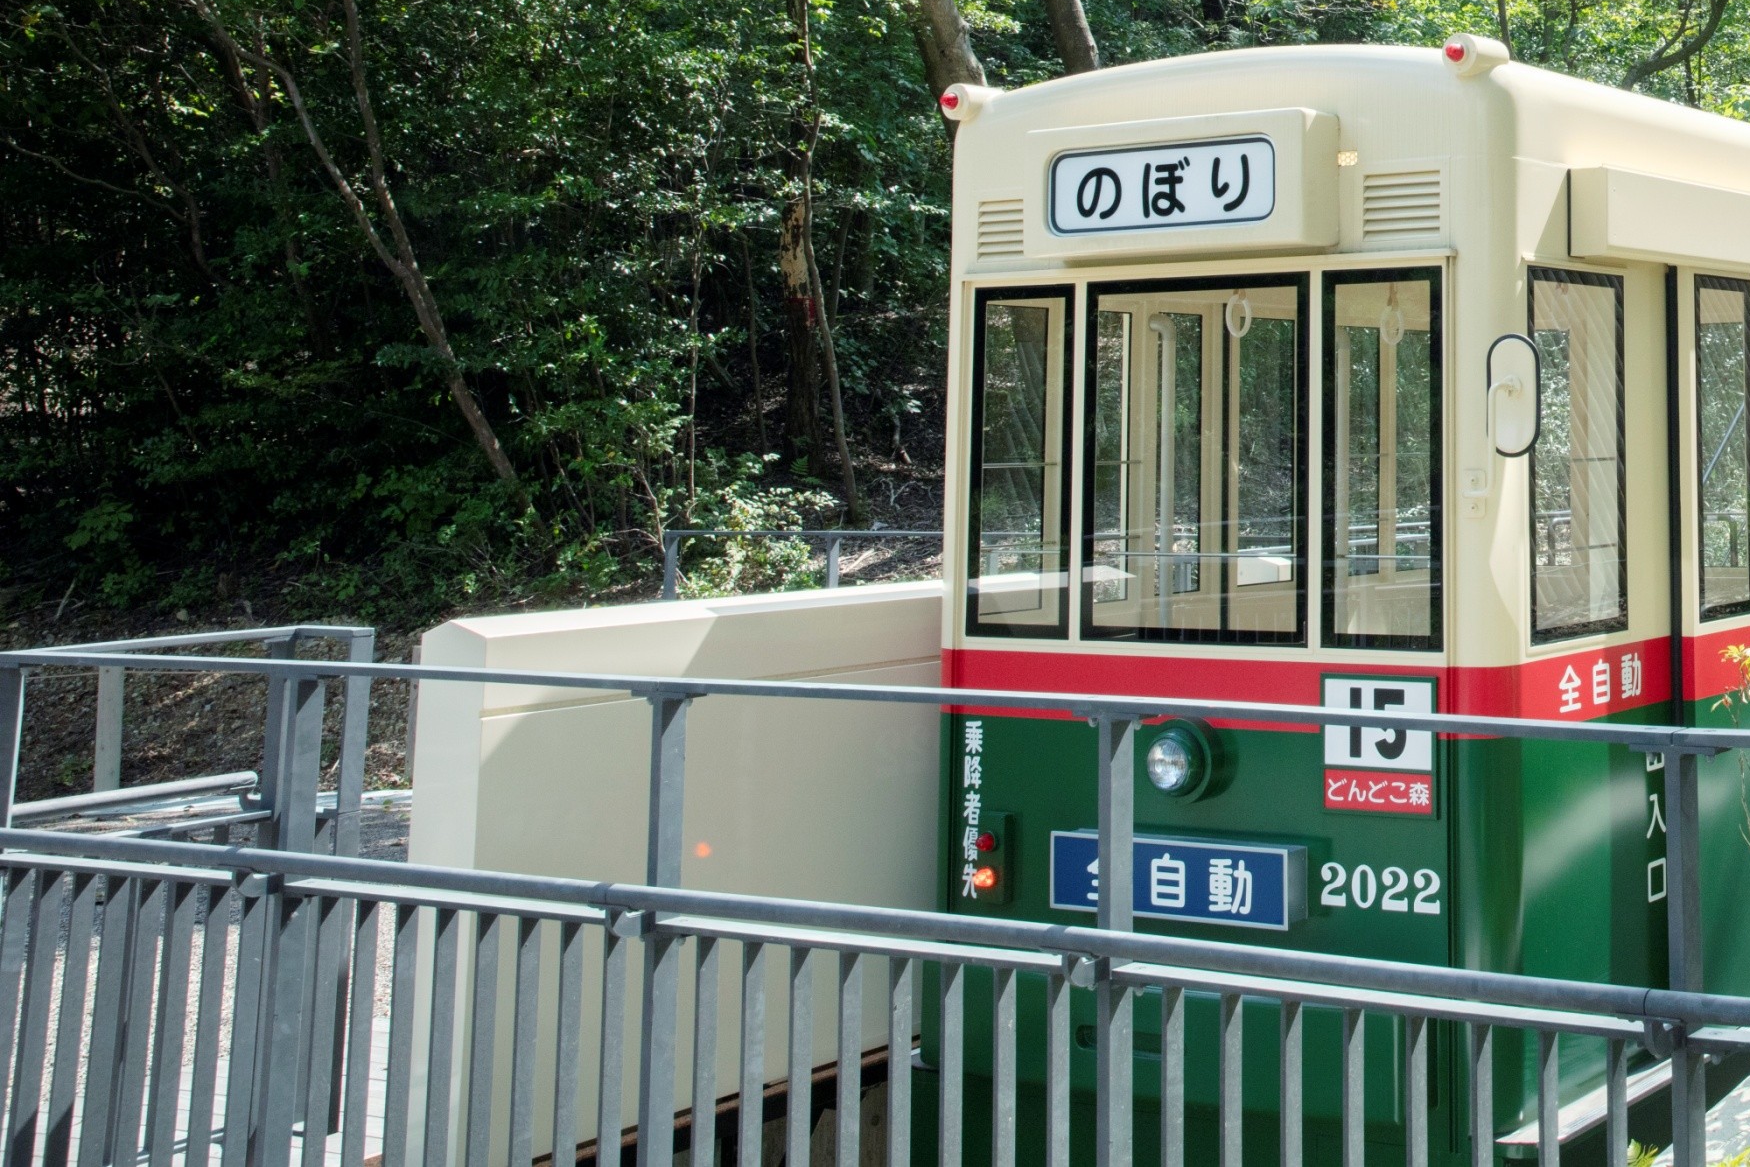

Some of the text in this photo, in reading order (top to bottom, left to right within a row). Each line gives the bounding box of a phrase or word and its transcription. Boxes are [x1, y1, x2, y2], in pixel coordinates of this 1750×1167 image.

[1077, 154, 1250, 220] のぼり
[1558, 654, 1643, 713] 全自動
[1350, 687, 1407, 760] 15
[1327, 778, 1429, 806] どんどこ森
[1646, 752, 1667, 903] 入口
[1320, 862, 1441, 914] 2022
